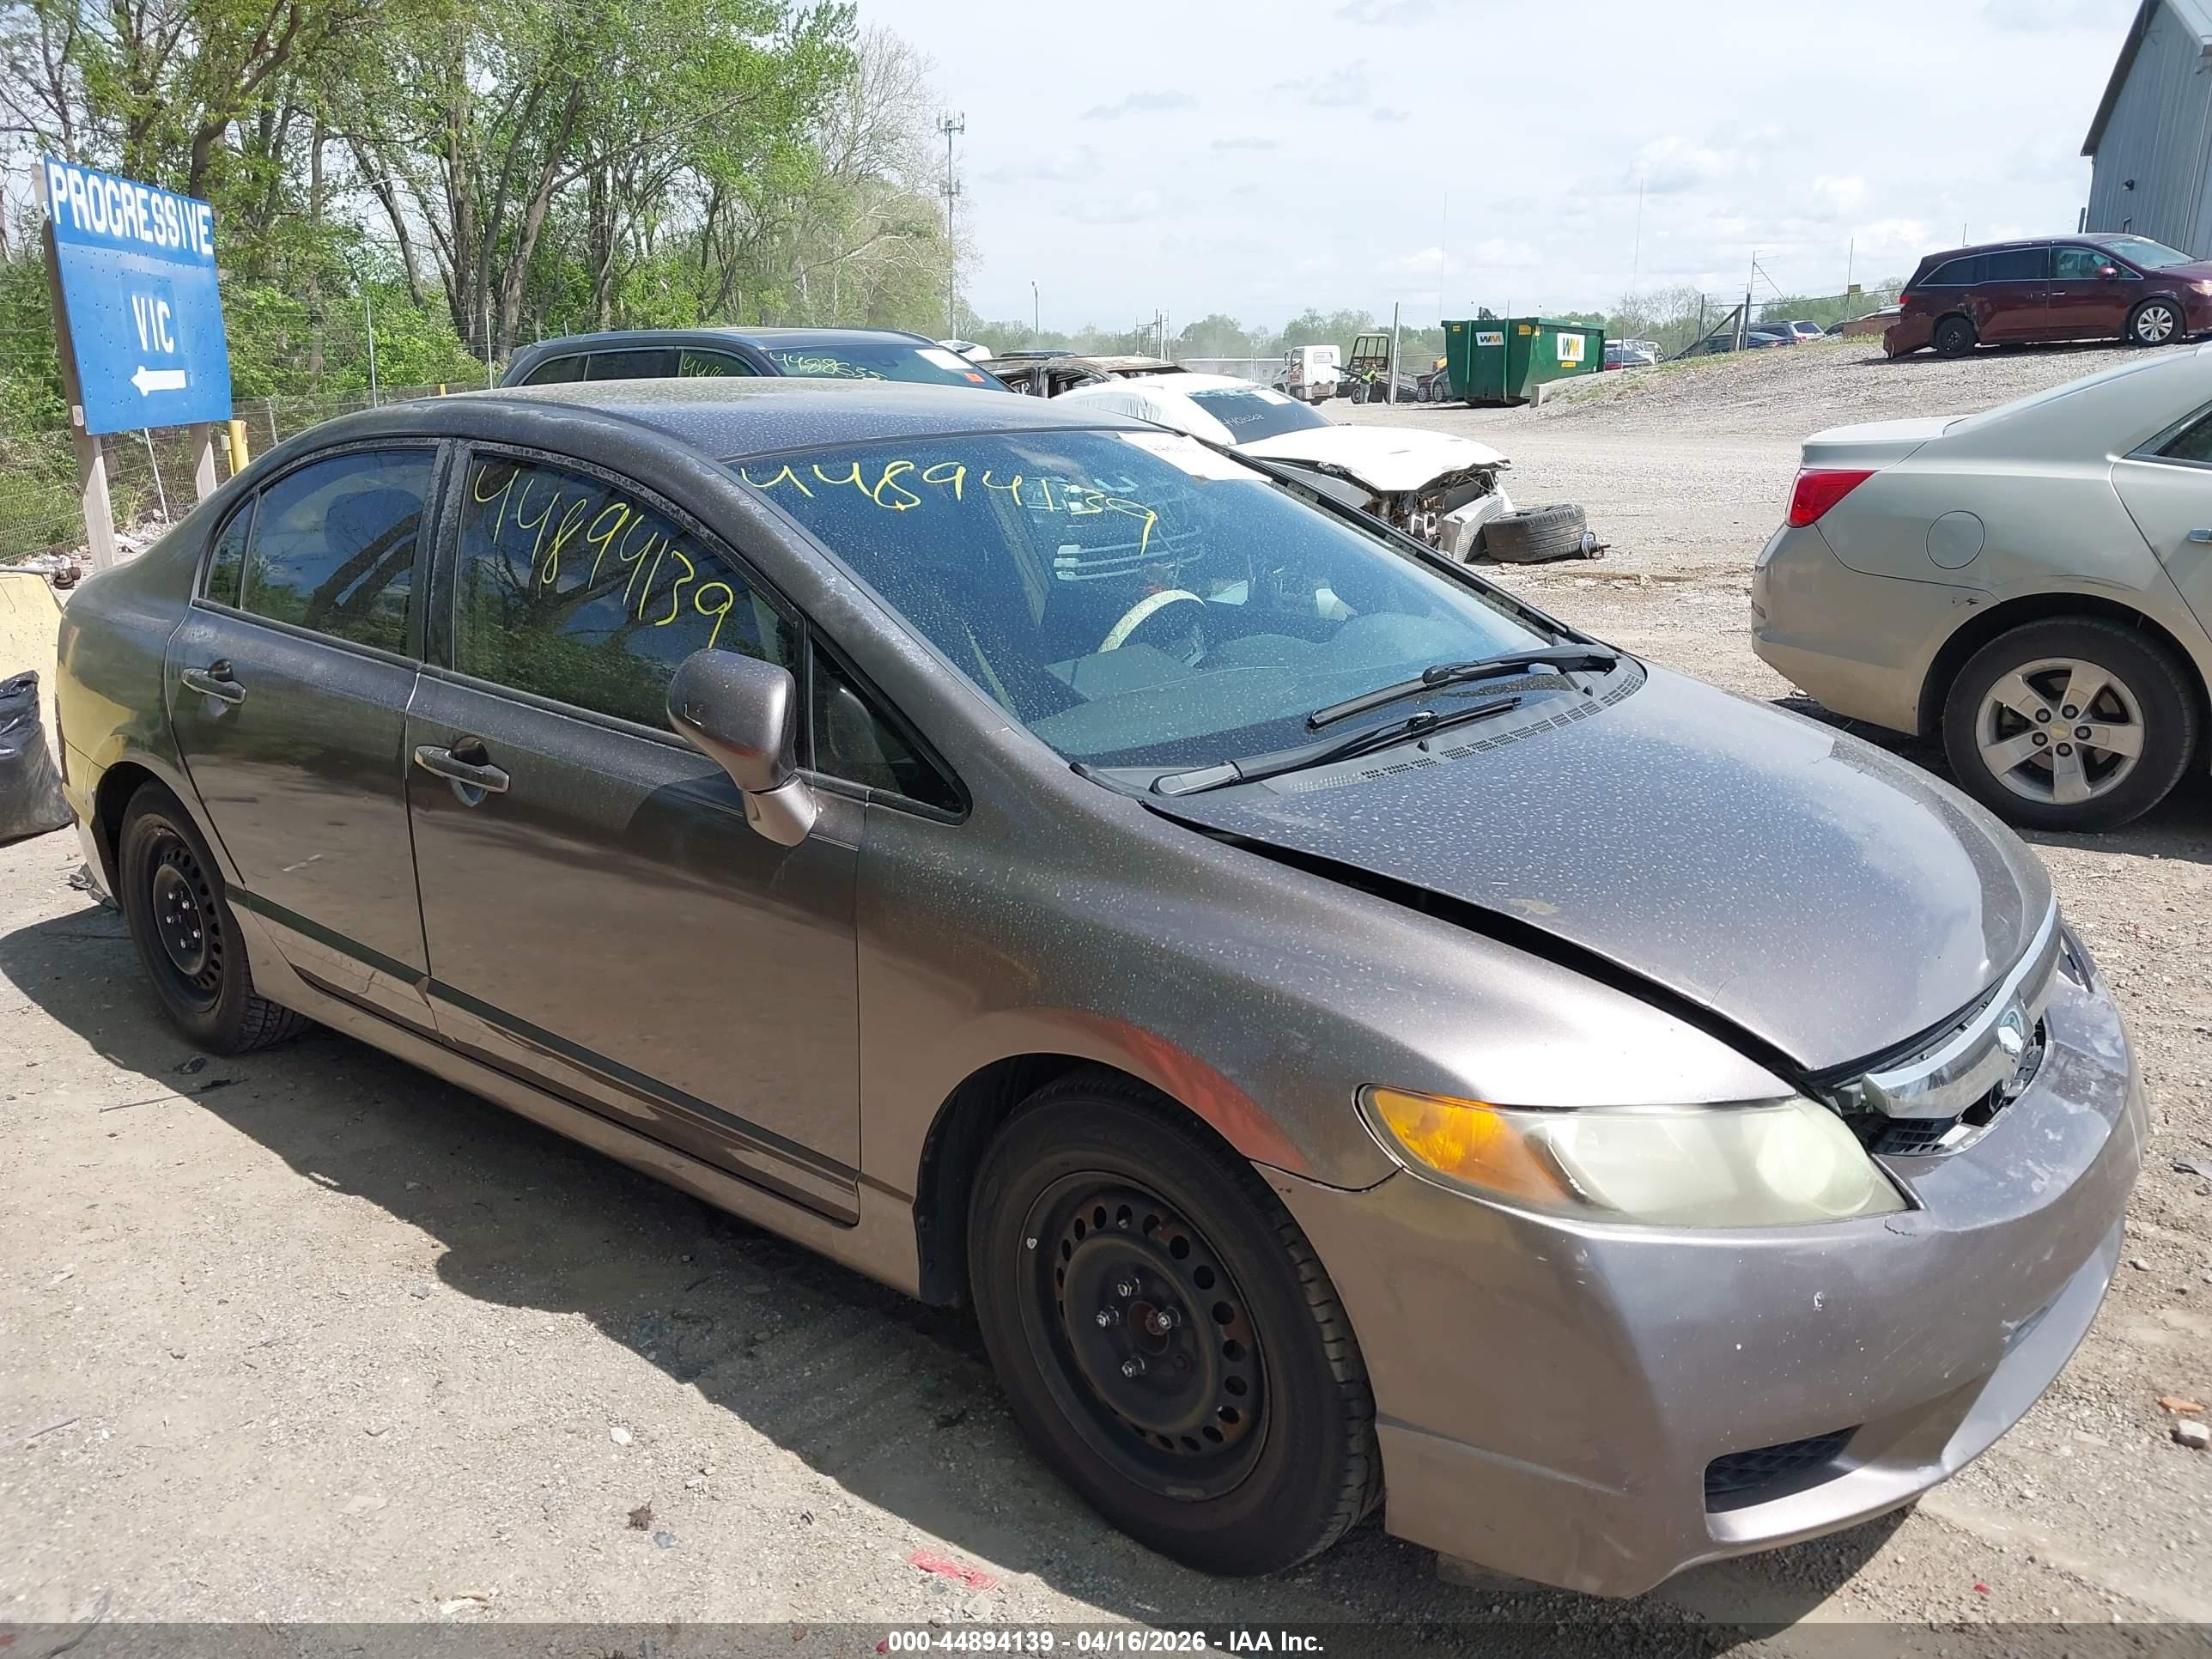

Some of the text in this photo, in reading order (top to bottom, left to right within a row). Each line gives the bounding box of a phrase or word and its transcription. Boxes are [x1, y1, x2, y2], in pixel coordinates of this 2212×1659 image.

[49, 163, 214, 256] PROGRESSIVE
[131, 295, 175, 354] VIC
[1480, 335, 1502, 343] WM
[740, 459, 1158, 555] 44894139
[474, 464, 735, 649] 44894139
